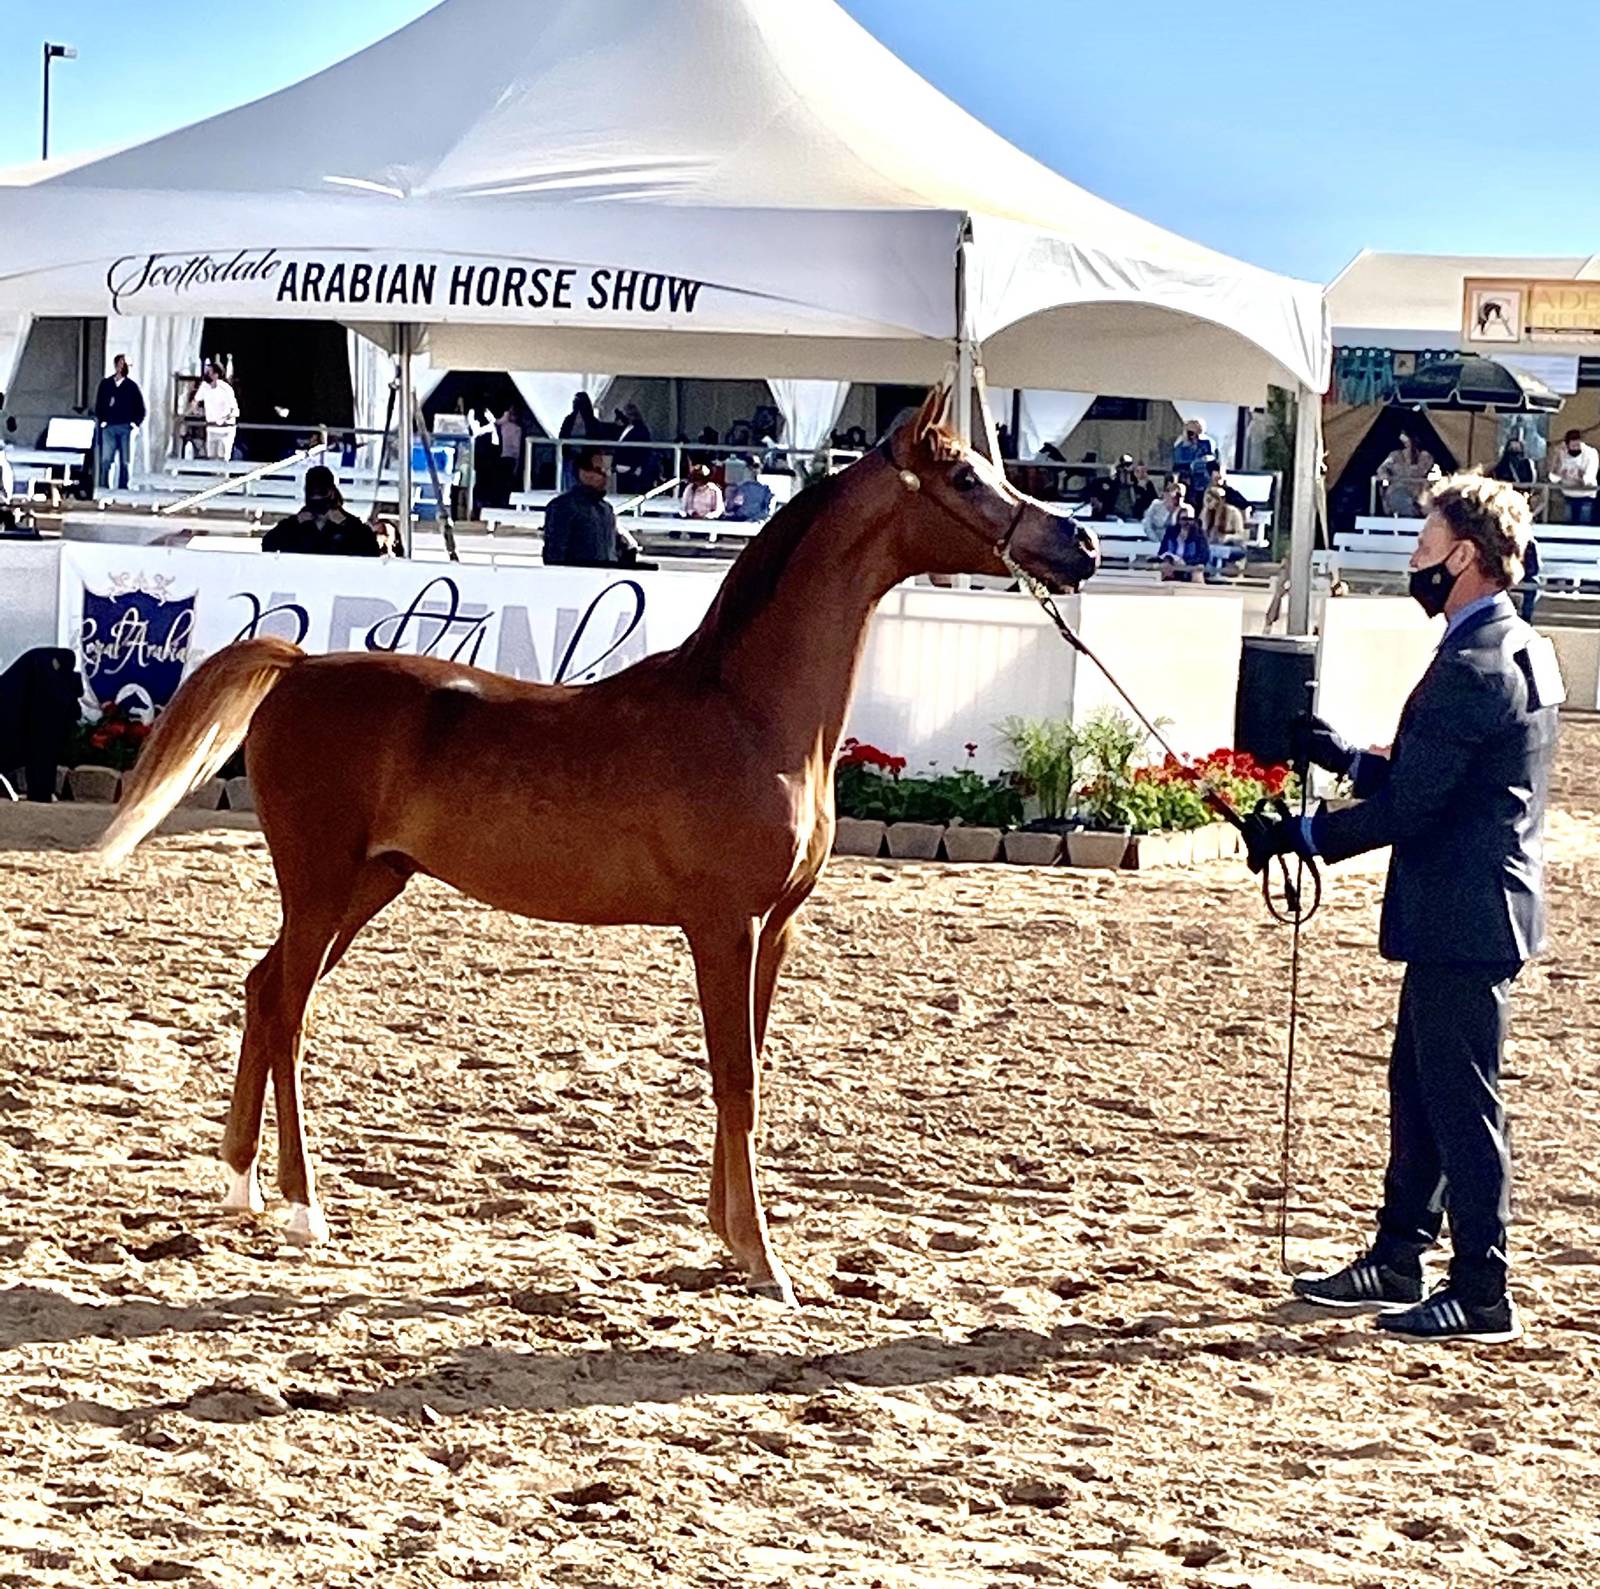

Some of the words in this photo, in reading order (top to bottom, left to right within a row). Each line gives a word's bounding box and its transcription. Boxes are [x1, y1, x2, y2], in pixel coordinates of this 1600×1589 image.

[107, 248, 282, 315] Scottsdale
[276, 262, 437, 305] ARABIAN
[449, 265, 577, 308] HORSE
[587, 269, 702, 313] SHOW
